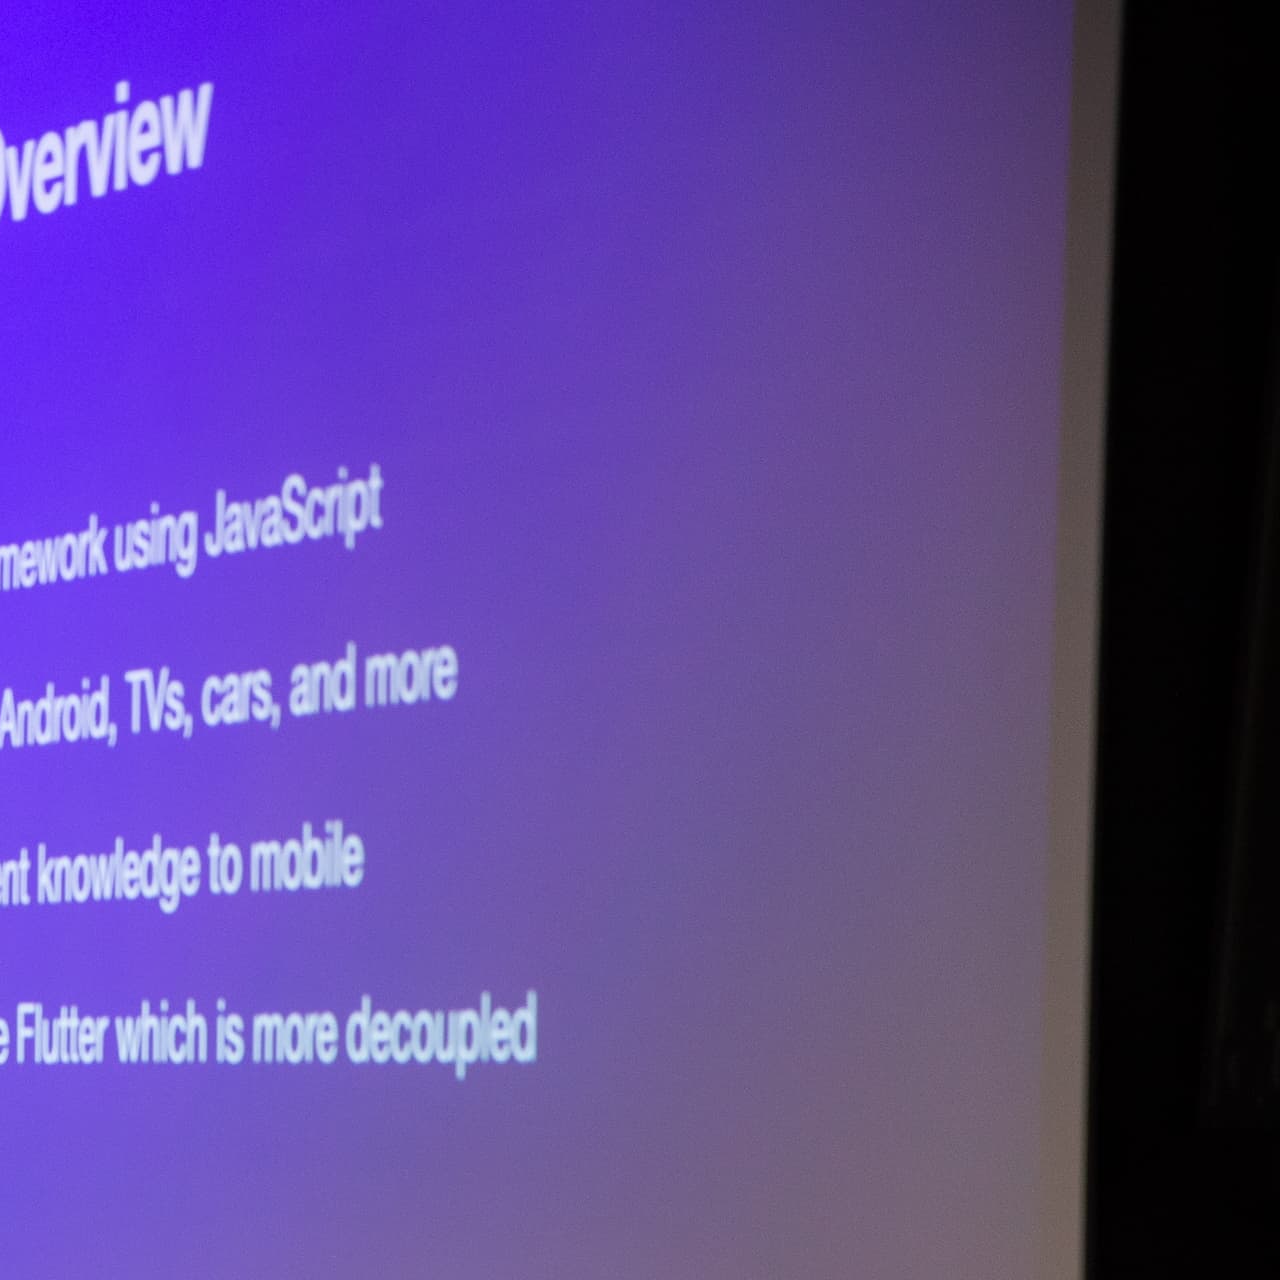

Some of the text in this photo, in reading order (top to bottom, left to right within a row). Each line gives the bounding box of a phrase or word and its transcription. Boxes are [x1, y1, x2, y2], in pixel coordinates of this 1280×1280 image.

[113, 501, 199, 579] using
[203, 463, 385, 557] JavaScript
[123, 666, 194, 739] TVs,
[200, 668, 282, 729] cars,
[288, 641, 357, 718] and
[364, 644, 459, 708] more
[36, 833, 202, 915] knowledge
[206, 832, 244, 895] to
[249, 819, 366, 892] mobile
[15, 1001, 111, 1065] Flutter
[114, 998, 208, 1065] which
[215, 997, 246, 1065] is
[251, 1011, 340, 1065] more
[344, 990, 538, 1080] decoupled
